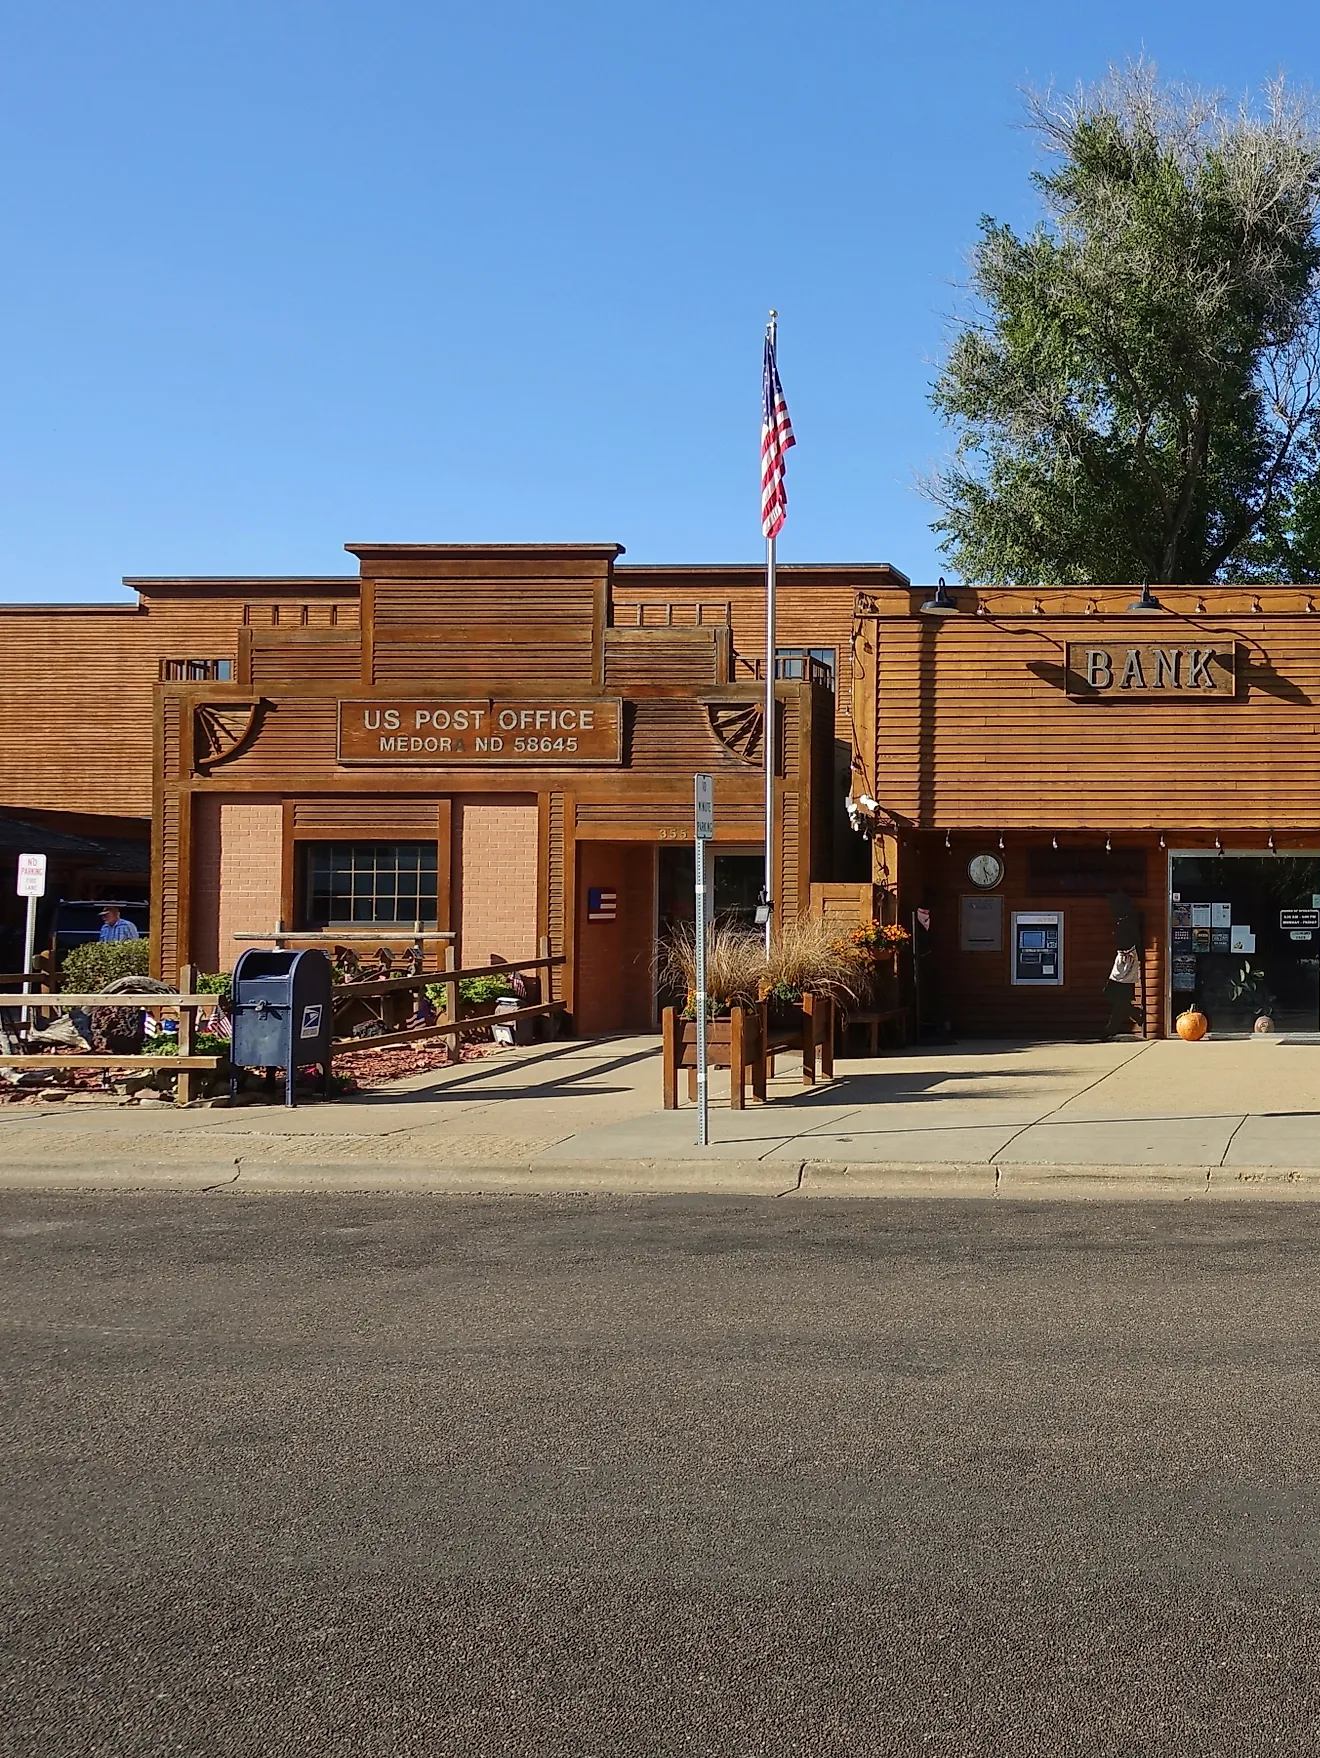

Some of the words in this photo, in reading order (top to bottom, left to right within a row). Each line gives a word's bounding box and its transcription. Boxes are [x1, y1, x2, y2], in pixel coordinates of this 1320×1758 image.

[1085, 649, 1215, 688] BANK
[363, 709, 401, 730] US
[414, 709, 485, 730] POST
[498, 709, 595, 730] OFFICE
[475, 737, 504, 752] ND
[513, 737, 578, 752] 58645
[697, 821, 713, 832] PARKING
[659, 828, 688, 839] 355
[27, 859, 38, 867] NO
[21, 867, 43, 876] PARKING
